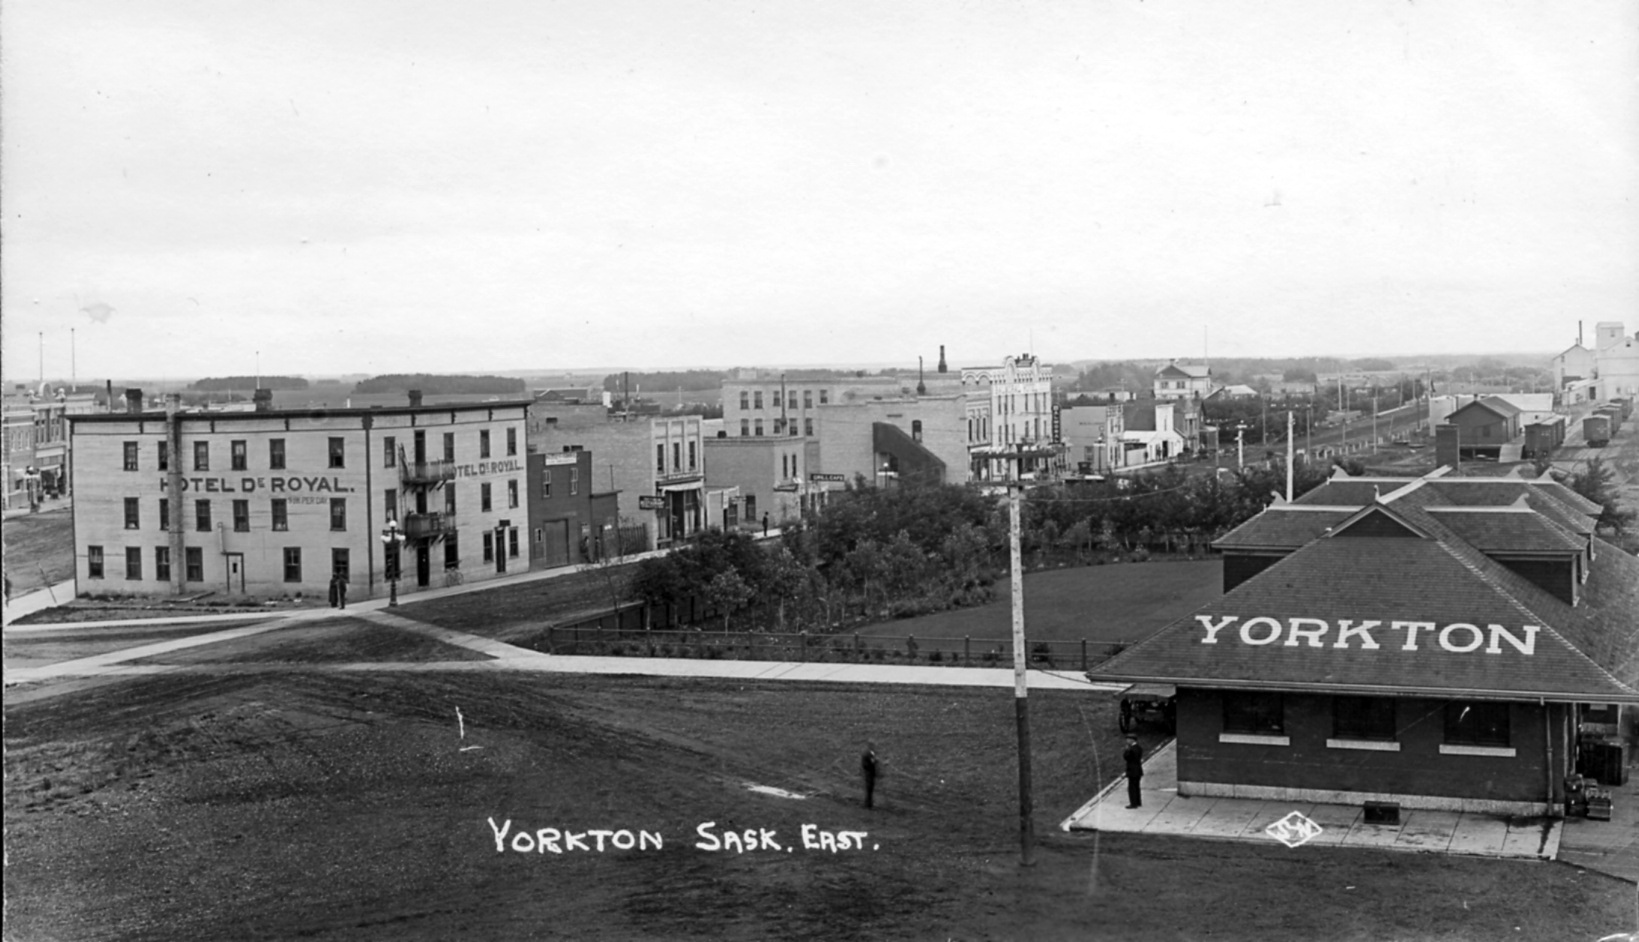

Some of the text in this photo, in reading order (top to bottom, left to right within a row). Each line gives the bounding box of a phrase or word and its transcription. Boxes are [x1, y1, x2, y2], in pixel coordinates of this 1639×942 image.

[453, 464, 478, 477] TEL
[271, 477, 355, 493] ROYAL.
[1195, 615, 1541, 655] YORKTON
